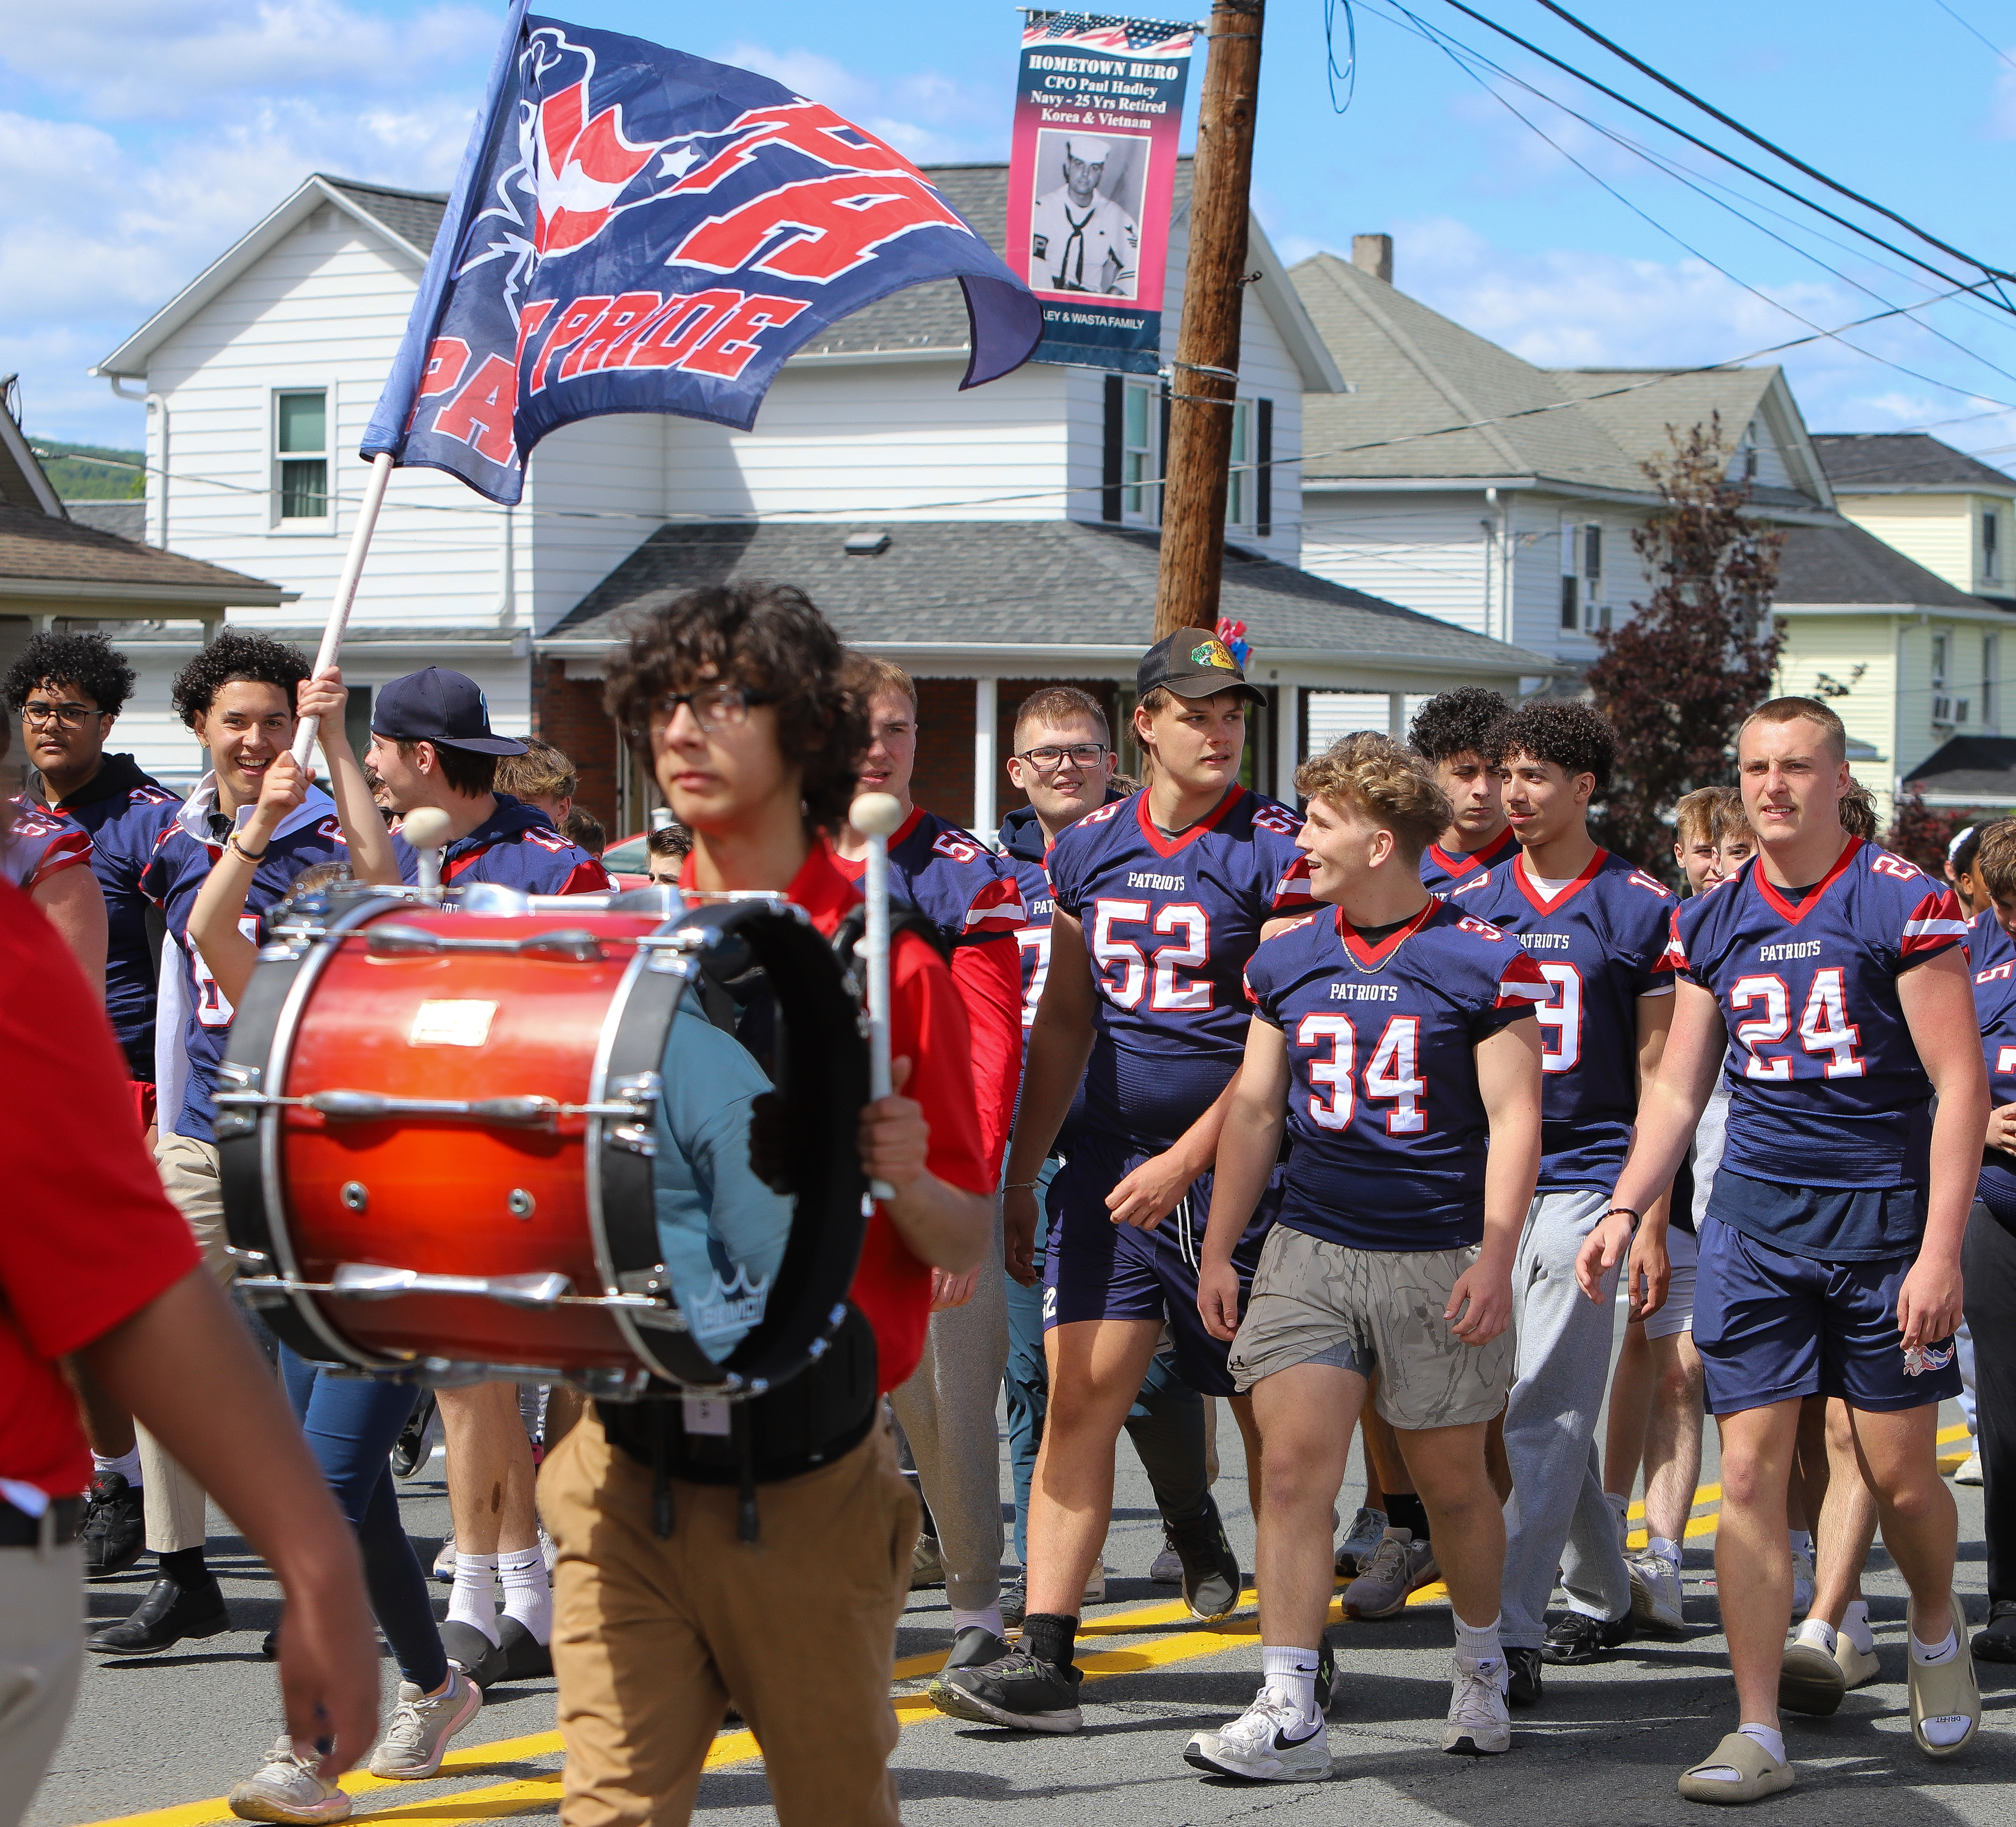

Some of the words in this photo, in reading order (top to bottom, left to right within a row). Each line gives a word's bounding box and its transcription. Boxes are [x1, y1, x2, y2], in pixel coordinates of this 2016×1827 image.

[1028, 54, 1126, 77] HOMETOWN
[1129, 62, 1179, 81] HERO
[1044, 74, 1077, 90] CPO
[1079, 77, 1108, 94] Paul
[1112, 80, 1158, 99] Hadley
[1030, 90, 1064, 108] Navy
[1075, 93, 1091, 108] 25
[1093, 95, 1117, 110] Yrs
[1118, 97, 1167, 114] Retired
[1041, 107, 1079, 124] Korea
[1082, 111, 1095, 125] &
[1098, 112, 1152, 129] Vietnam
[1062, 312, 1070, 323] &
[1072, 313, 1108, 326] WASTA
[1108, 317, 1145, 330] FAMILY
[557, 288, 813, 382] PRIDE
[1213, 641, 1227, 650] Ba
[1127, 872, 1185, 891] PATRIOTS
[1091, 897, 1215, 1013] 52
[1759, 940, 1821, 962] PATRIOTS
[1329, 983, 1398, 1002] PATRIOTS
[1730, 966, 1867, 1082] 24
[1296, 1011, 1428, 1135] 34
